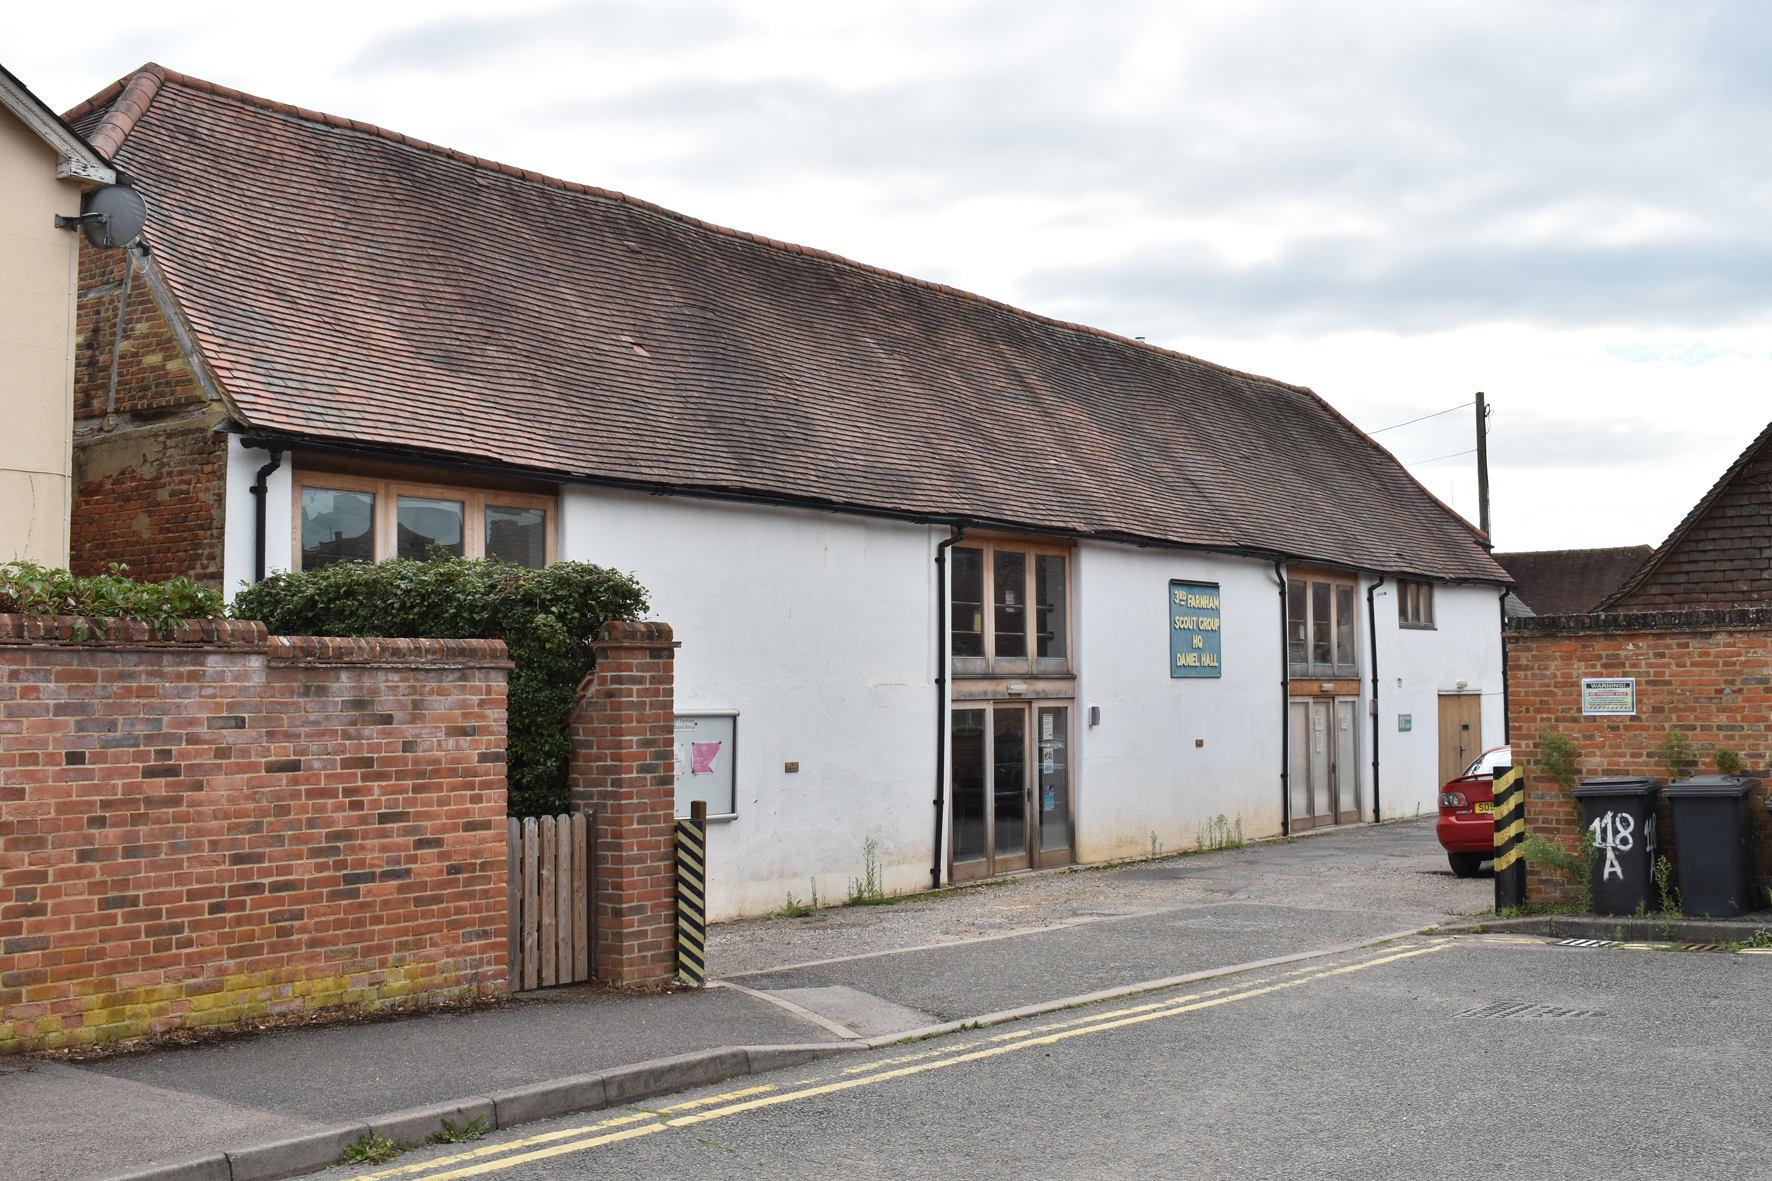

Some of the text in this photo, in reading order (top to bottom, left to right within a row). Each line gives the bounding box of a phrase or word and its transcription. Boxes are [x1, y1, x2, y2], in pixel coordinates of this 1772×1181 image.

[1187, 594, 1219, 609] FARNHAM
[1174, 616, 1219, 631] SCOUT GROUP
[1192, 634, 1203, 648] HQ
[1176, 653, 1218, 667] DANIEL HALL
[1588, 810, 1634, 851] 118
[1603, 847, 1624, 882] A
